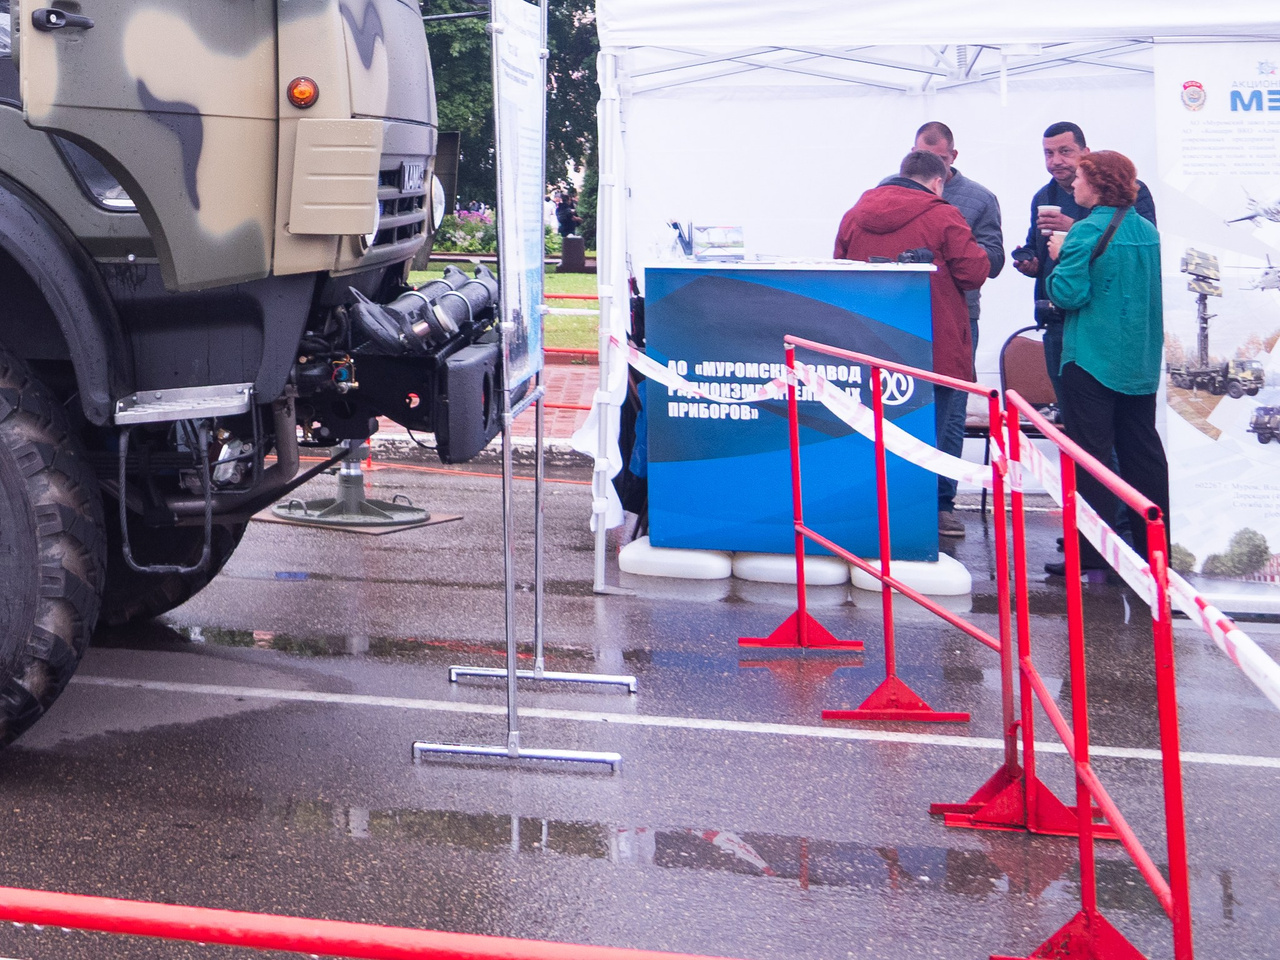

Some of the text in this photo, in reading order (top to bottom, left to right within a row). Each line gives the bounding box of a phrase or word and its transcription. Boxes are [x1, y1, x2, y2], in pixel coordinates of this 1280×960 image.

[1232, 80, 1280, 89] АКЦИОН
[695, 360, 800, 381] «МУРОМСК
[667, 401, 759, 420] ПРИБОРОВ»
